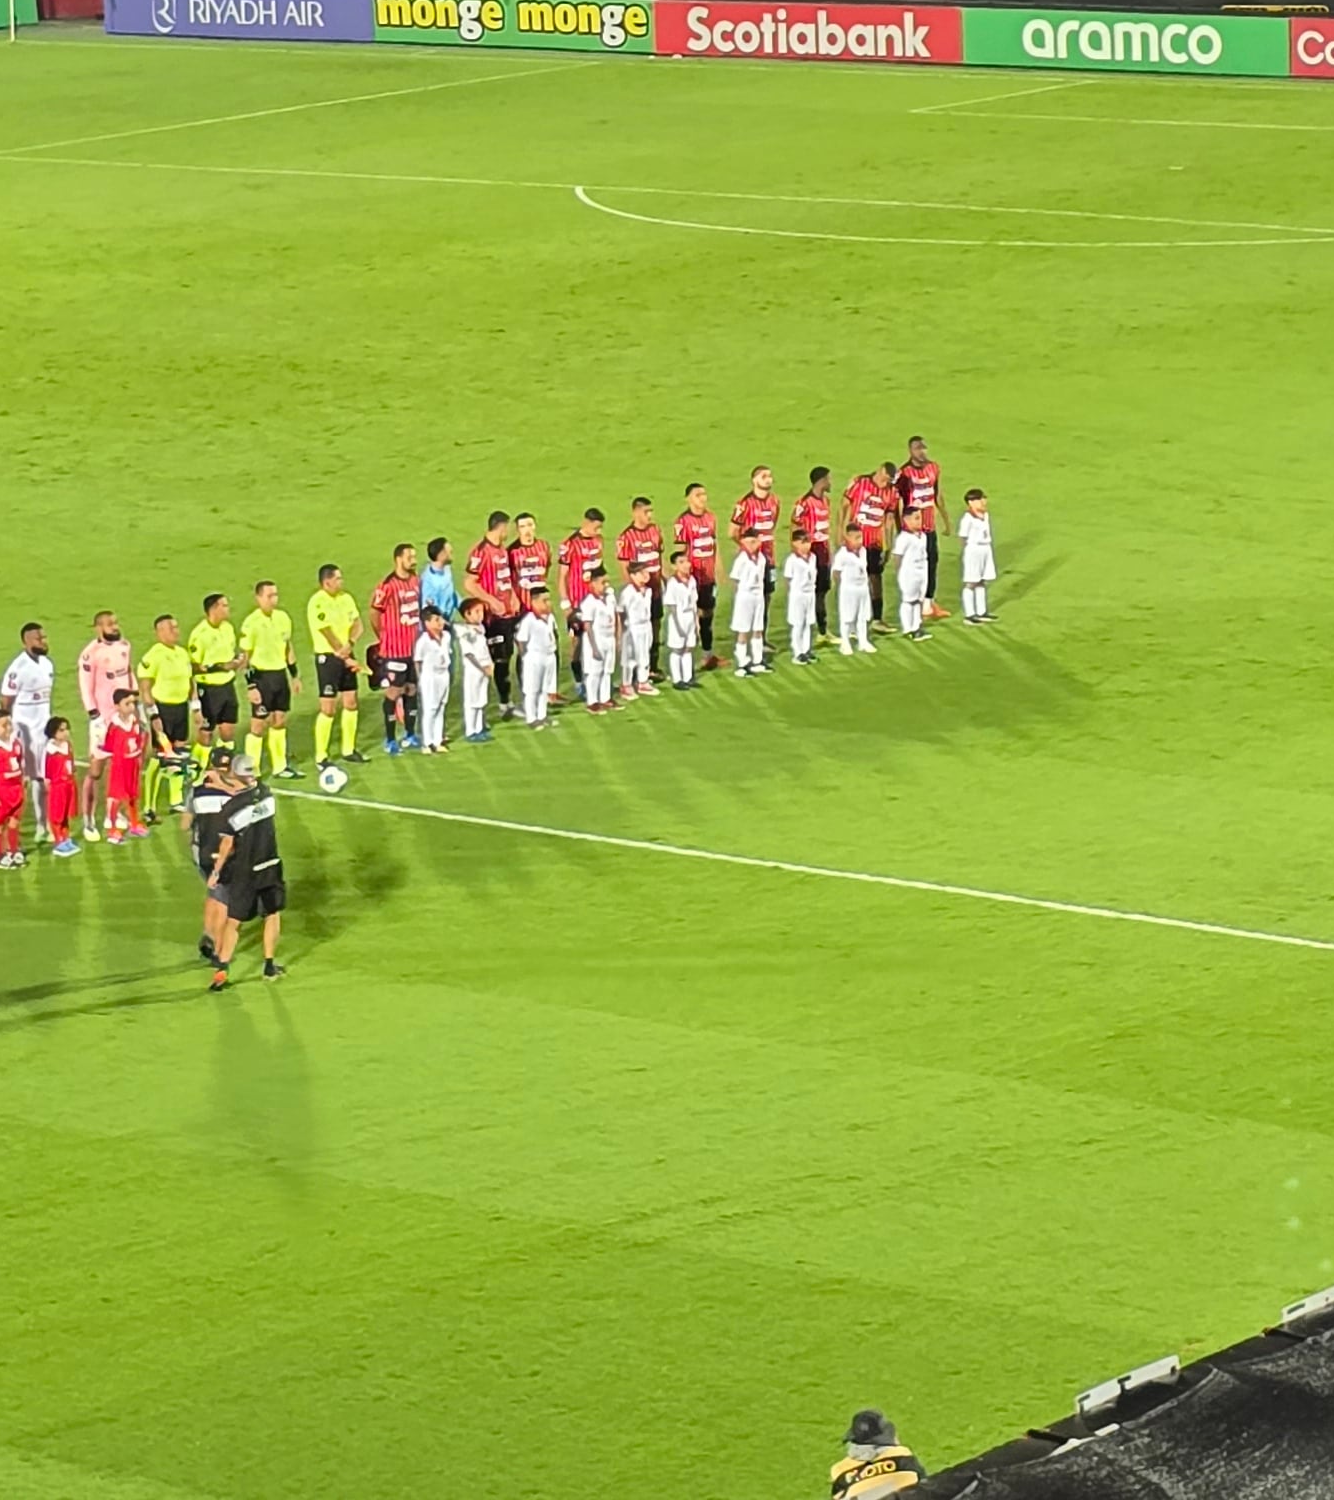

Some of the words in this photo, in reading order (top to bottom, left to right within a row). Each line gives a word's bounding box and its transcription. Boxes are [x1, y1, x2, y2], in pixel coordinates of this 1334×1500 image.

[283, 0, 325, 27] AIR
[517, 0, 649, 48] monge
[686, 6, 931, 58] Scotiabank
[1022, 19, 1223, 65] aramco
